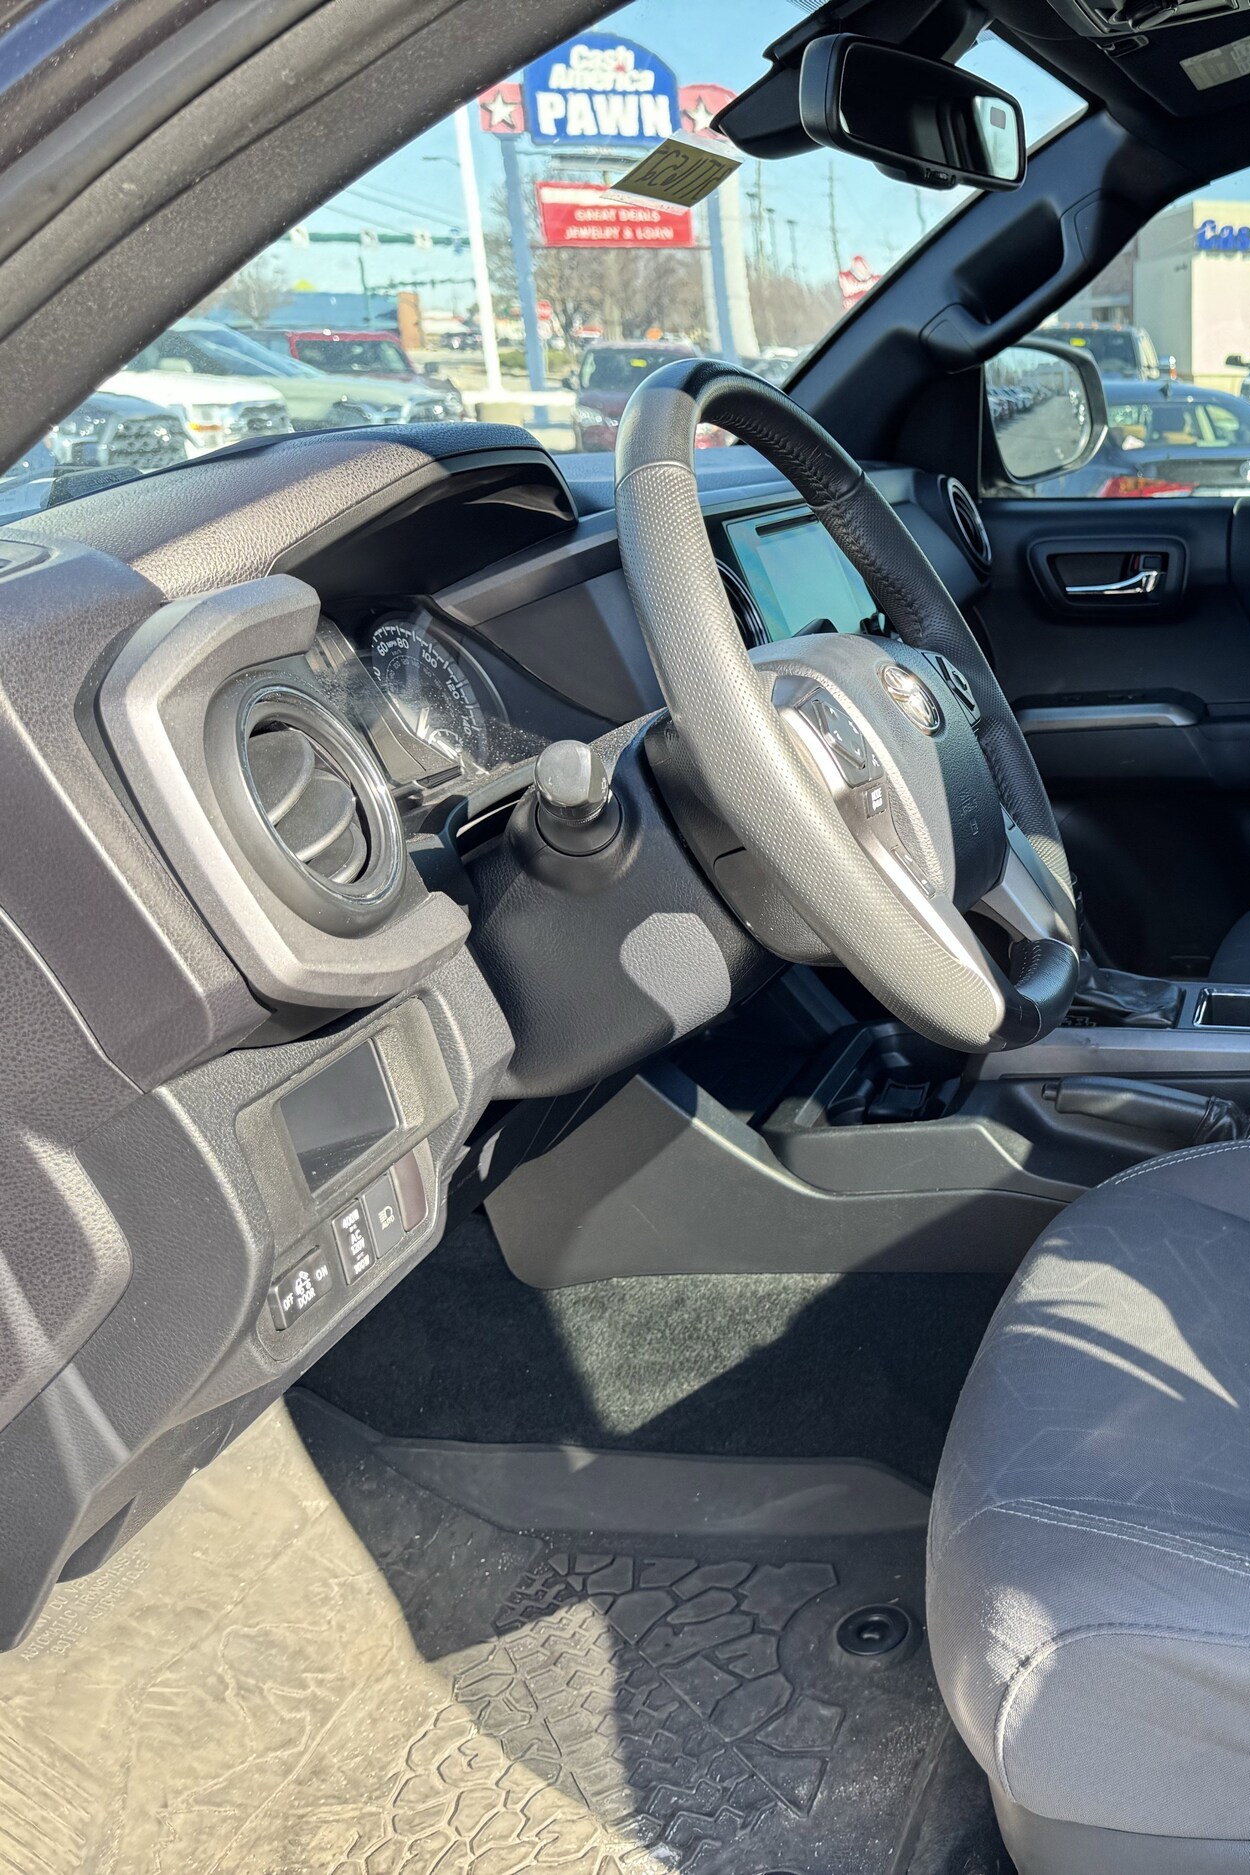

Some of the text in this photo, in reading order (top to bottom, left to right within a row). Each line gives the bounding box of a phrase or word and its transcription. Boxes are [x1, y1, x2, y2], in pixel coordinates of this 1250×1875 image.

[569, 44, 635, 72] Cash
[548, 63, 655, 92] America
[535, 91, 673, 138] PAWN
[574, 208, 661, 222] GREAT DEALS
[377, 641, 389, 656] 60
[396, 637, 409, 649] 80
[422, 649, 438, 668] 100
[445, 679, 460, 699] 120
[461, 715, 472, 735] 140
[381, 1214, 395, 1231] AUTO
[350, 1237, 365, 1256] 120V
[351, 1229, 362, 1245] AC
[283, 1264, 328, 1312] OFF ON
[297, 1287, 316, 1310] DOOR
